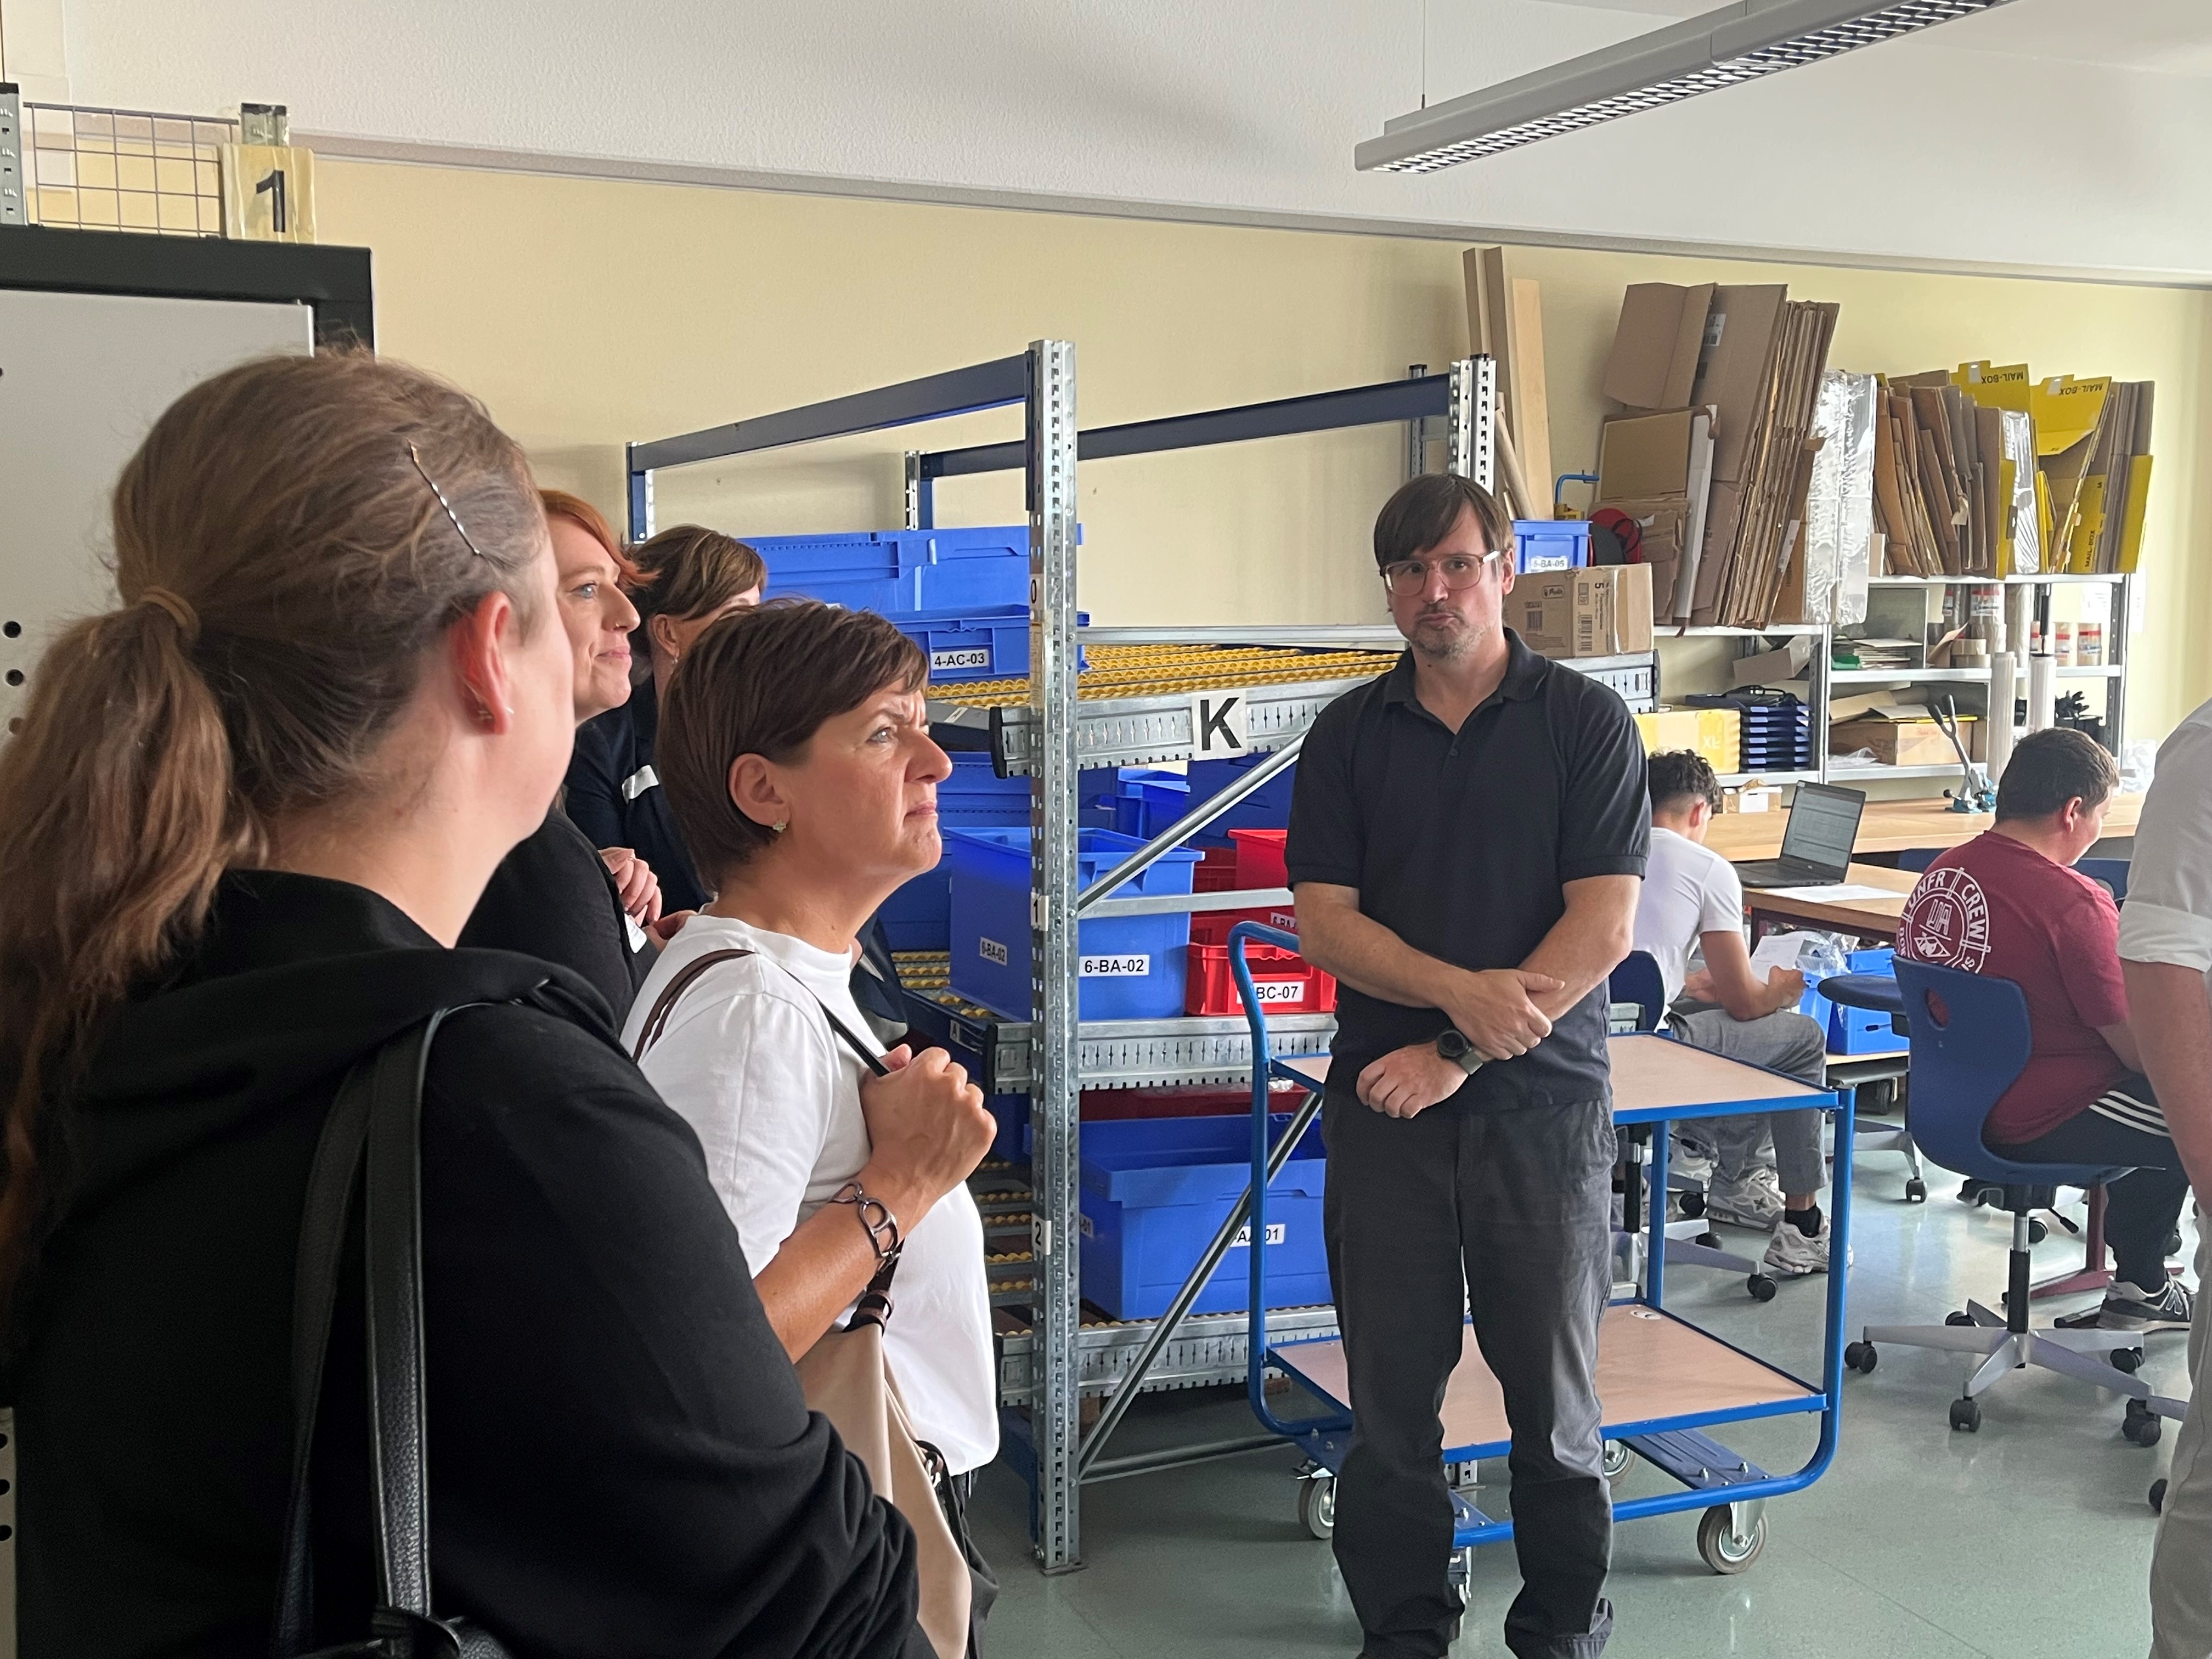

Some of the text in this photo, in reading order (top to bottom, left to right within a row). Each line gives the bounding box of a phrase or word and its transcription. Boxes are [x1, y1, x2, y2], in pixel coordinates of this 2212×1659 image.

[255, 169, 286, 233] 1
[1982, 371, 2024, 384] MAIL-BOX
[2058, 383, 2103, 396] MAIL-BOX
[2085, 530, 2095, 567] MAIL-BOX
[934, 653, 985, 667] 4-AC-03
[1200, 697, 1242, 752] K
[1034, 899, 1038, 923] 1
[1908, 871, 1985, 940] UNFR CREW
[1085, 959, 1144, 973] 6-BA-02
[1256, 986, 1298, 999] BC-07
[1035, 1221, 1041, 1247] 2
